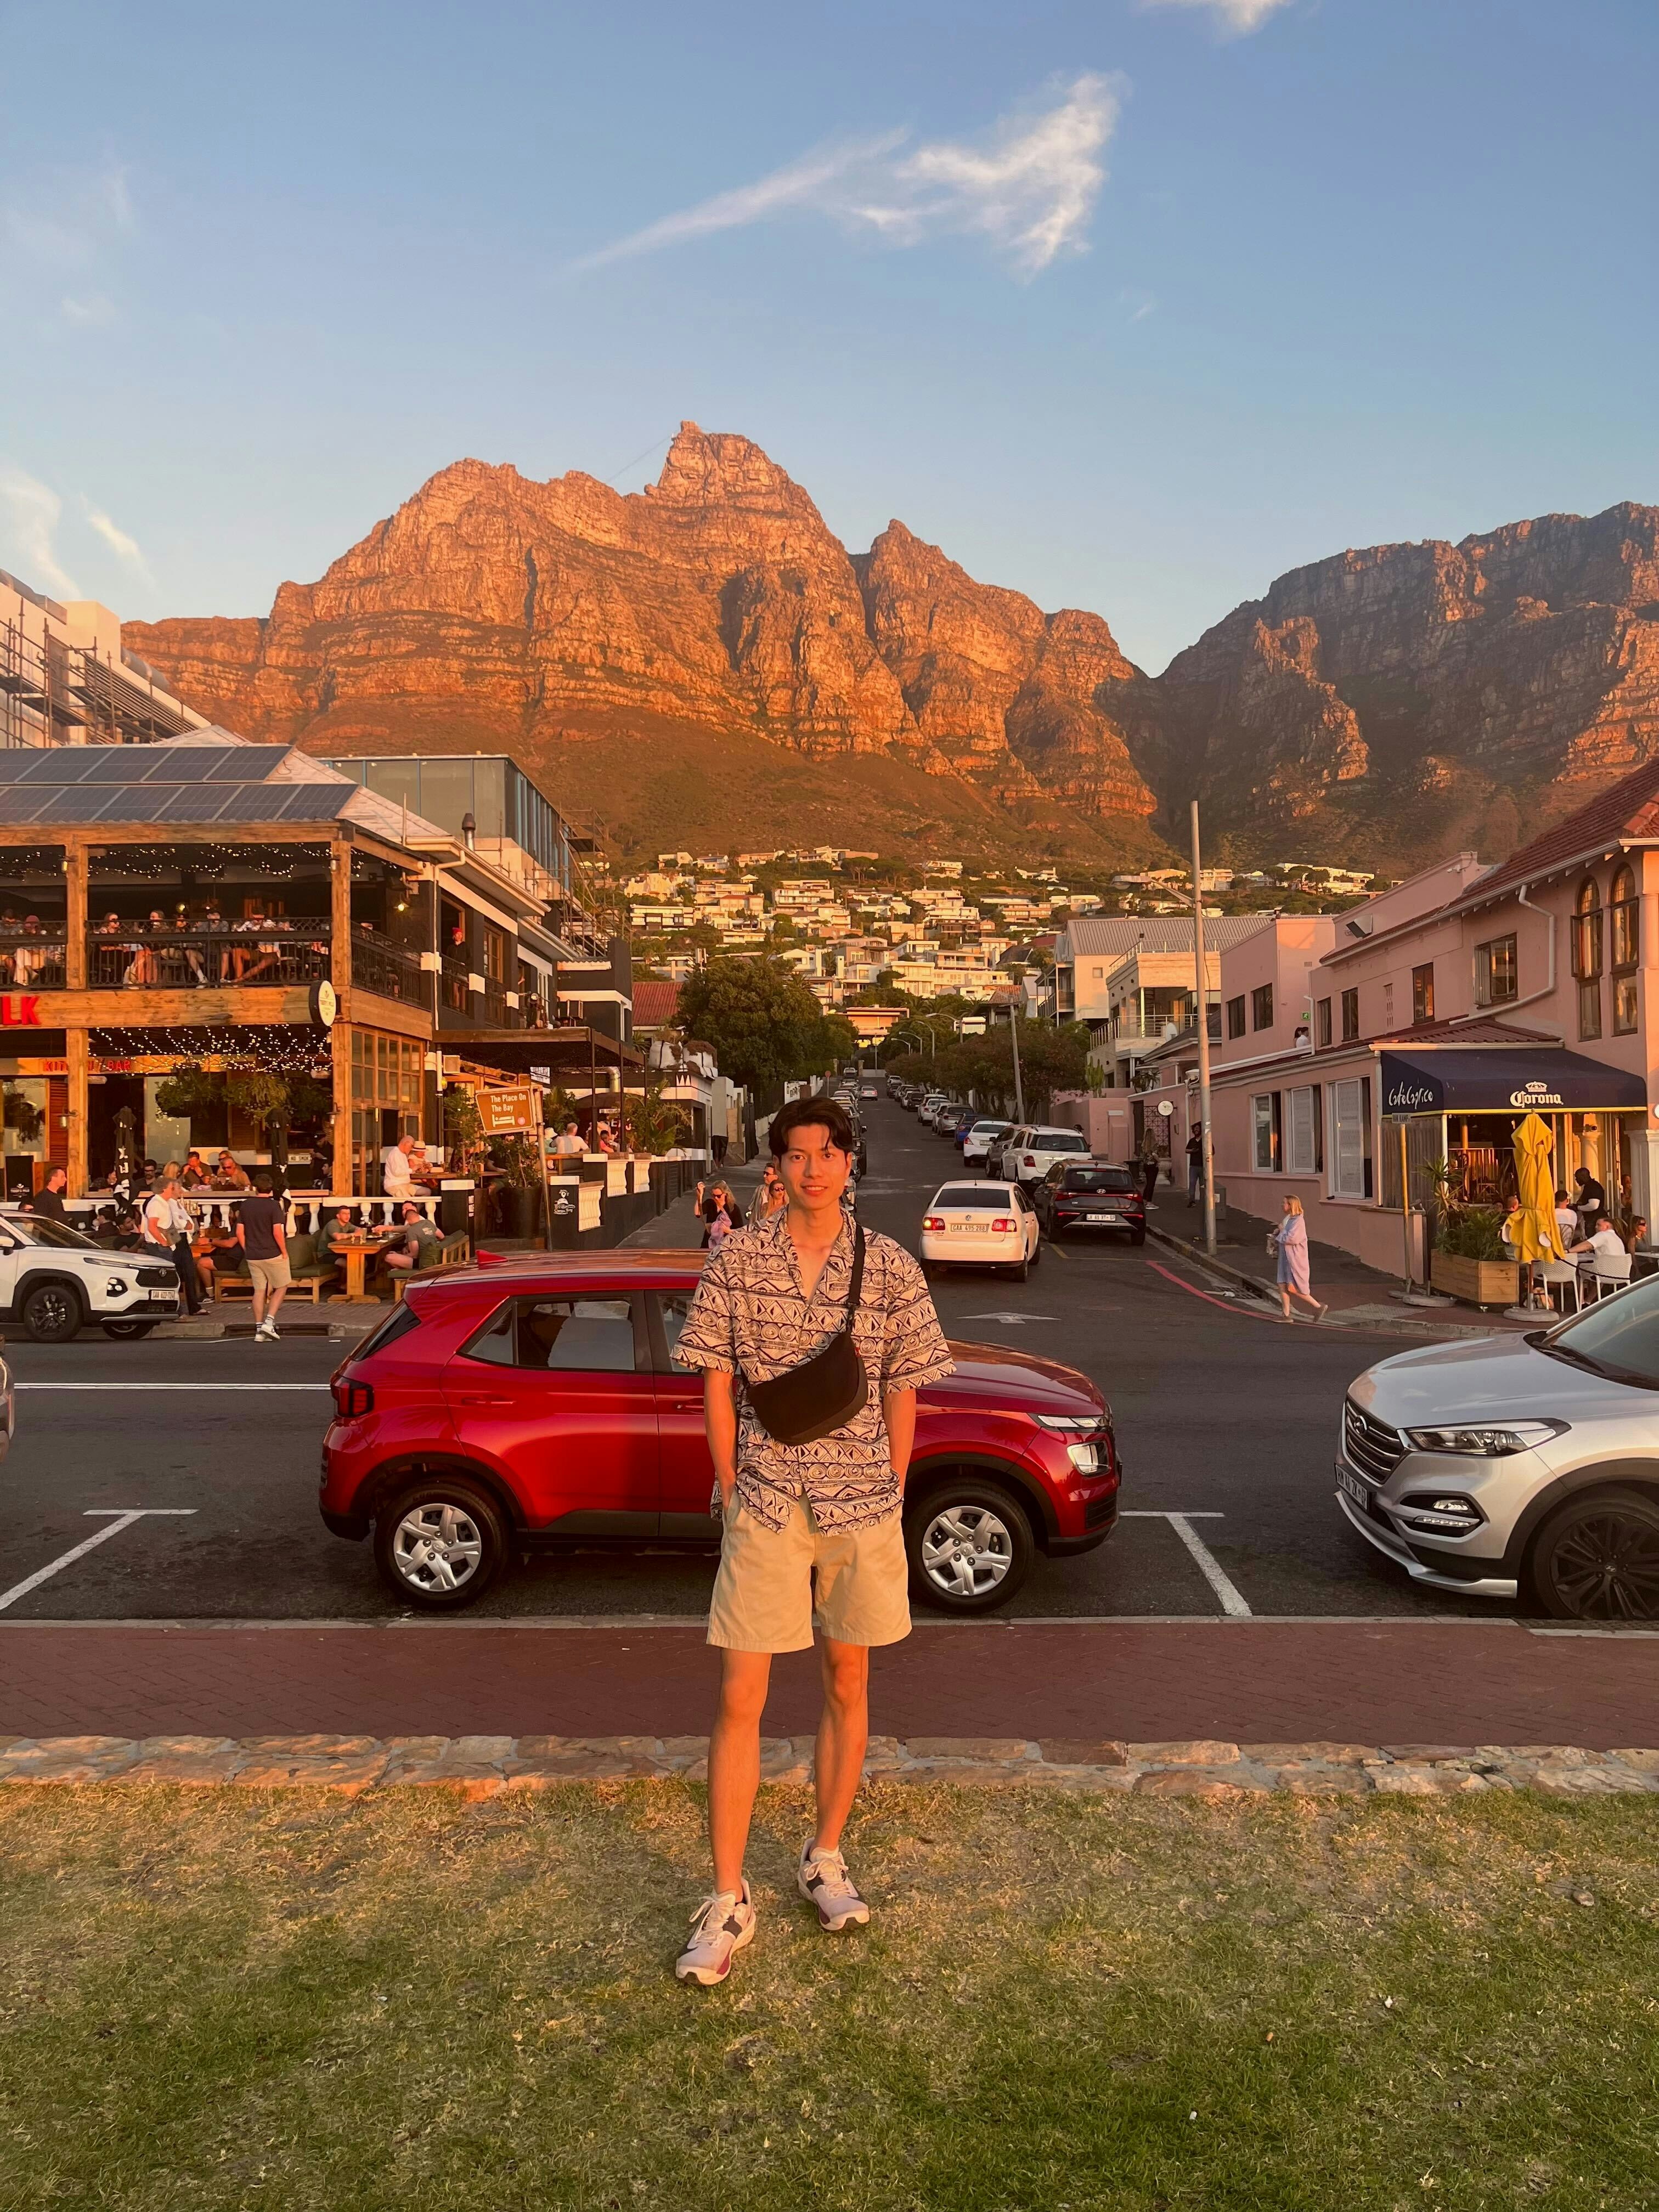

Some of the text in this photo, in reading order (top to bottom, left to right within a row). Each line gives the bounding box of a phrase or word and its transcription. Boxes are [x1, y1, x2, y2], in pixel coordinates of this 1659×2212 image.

[108, 1059, 131, 1070] BAR
[1510, 1091, 1562, 1108] Corona
[503, 1104, 514, 1113] Bay
